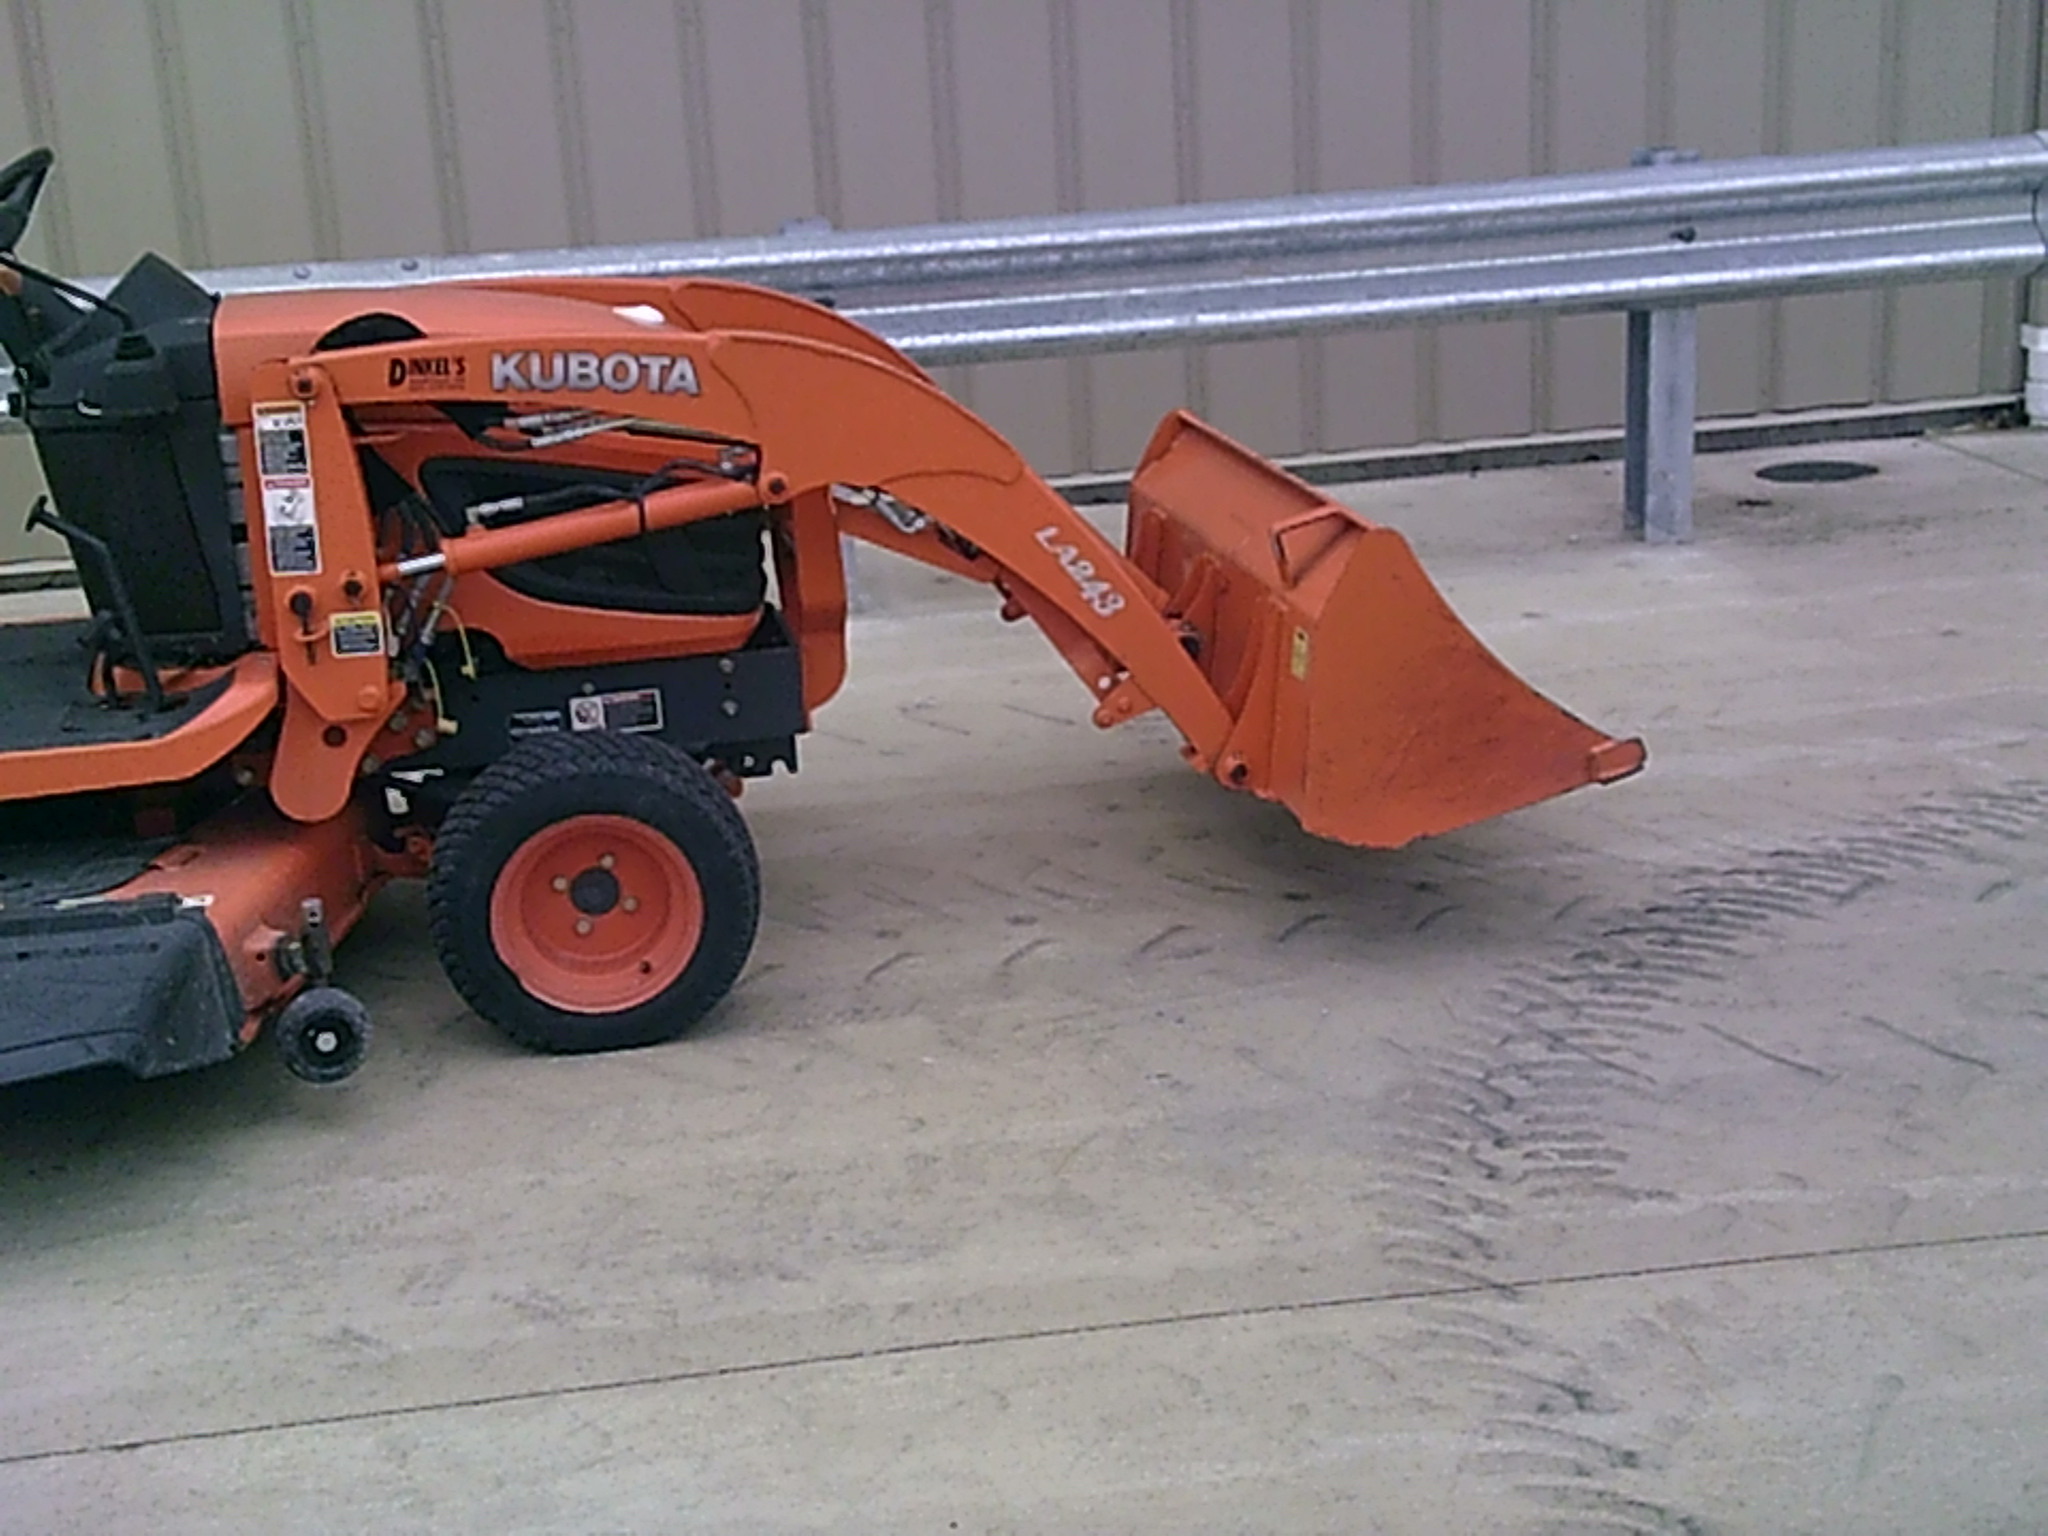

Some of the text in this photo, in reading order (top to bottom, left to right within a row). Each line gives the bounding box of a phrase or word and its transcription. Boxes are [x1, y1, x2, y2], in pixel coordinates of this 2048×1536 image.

[388, 356, 466, 387] DINKEL'S
[490, 350, 700, 394] KUBOTA
[1035, 526, 1125, 616] LA243
